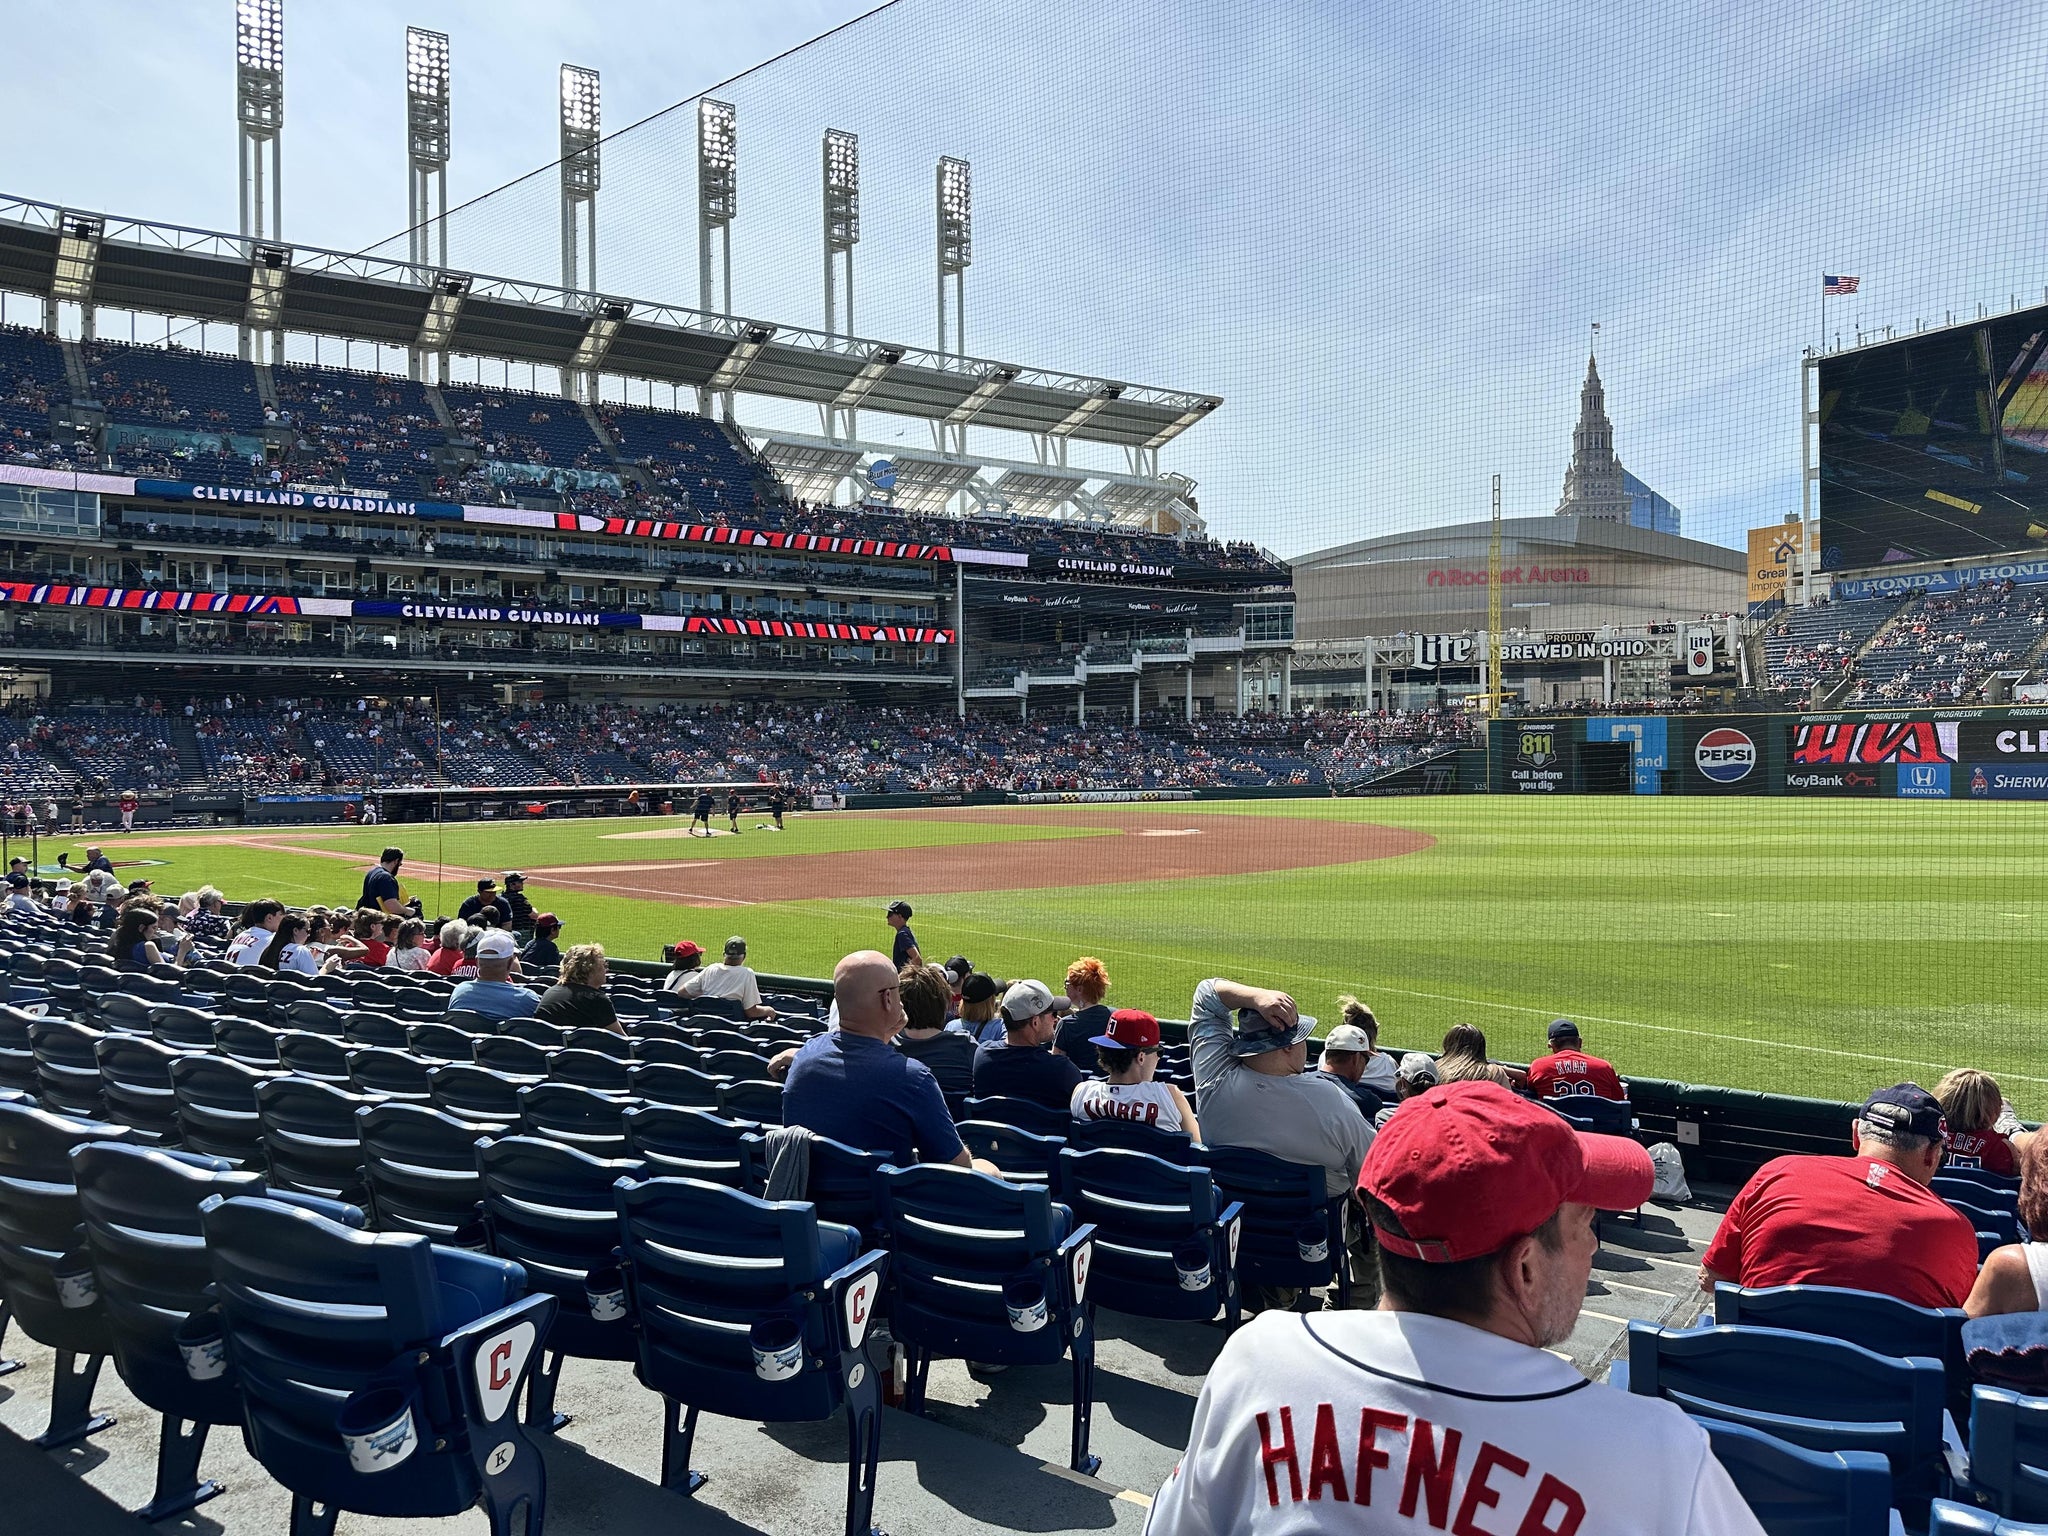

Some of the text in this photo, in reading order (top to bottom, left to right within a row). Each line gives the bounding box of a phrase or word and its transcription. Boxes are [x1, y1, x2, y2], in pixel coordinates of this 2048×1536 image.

[120, 432, 178, 448] ROBNSON
[192, 485, 416, 516] CLEVELAND GUARDIANS
[1057, 558, 1175, 578] CLEVELAND GUARDIAN
[1447, 565, 1590, 586] Rocet Arena
[1862, 573, 1949, 593] HONDA
[1003, 594, 1029, 603] KeyBank
[1128, 602, 1151, 611] KeyBank
[401, 604, 600, 626] CLEVELAND GUARDIANS
[1545, 632, 1596, 643] PROUDLY
[1690, 636, 1711, 651] Lite
[1409, 633, 1473, 671] Lite
[1500, 640, 1646, 660] BREWED IN OHIO
[1800, 714, 1844, 722] PROGRESSIVE
[1864, 712, 1911, 720] PROGRESSIVE
[1933, 710, 1984, 719] PROGRESSIVE
[1521, 734, 1551, 755] 811
[1699, 749, 1752, 761] PEPSI
[1511, 769, 1563, 780] Call before
[1786, 774, 1843, 788] KeyBank
[1473, 783, 1487, 791] 325
[1519, 779, 1556, 792] you dig.
[1901, 787, 1946, 795] HONDA
[1555, 1060, 1588, 1075] KWAN
[853, 1285, 866, 1325] C
[489, 1339, 513, 1391] C
[495, 1448, 508, 1468] K
[1255, 1402, 1587, 1536] HAFNER
